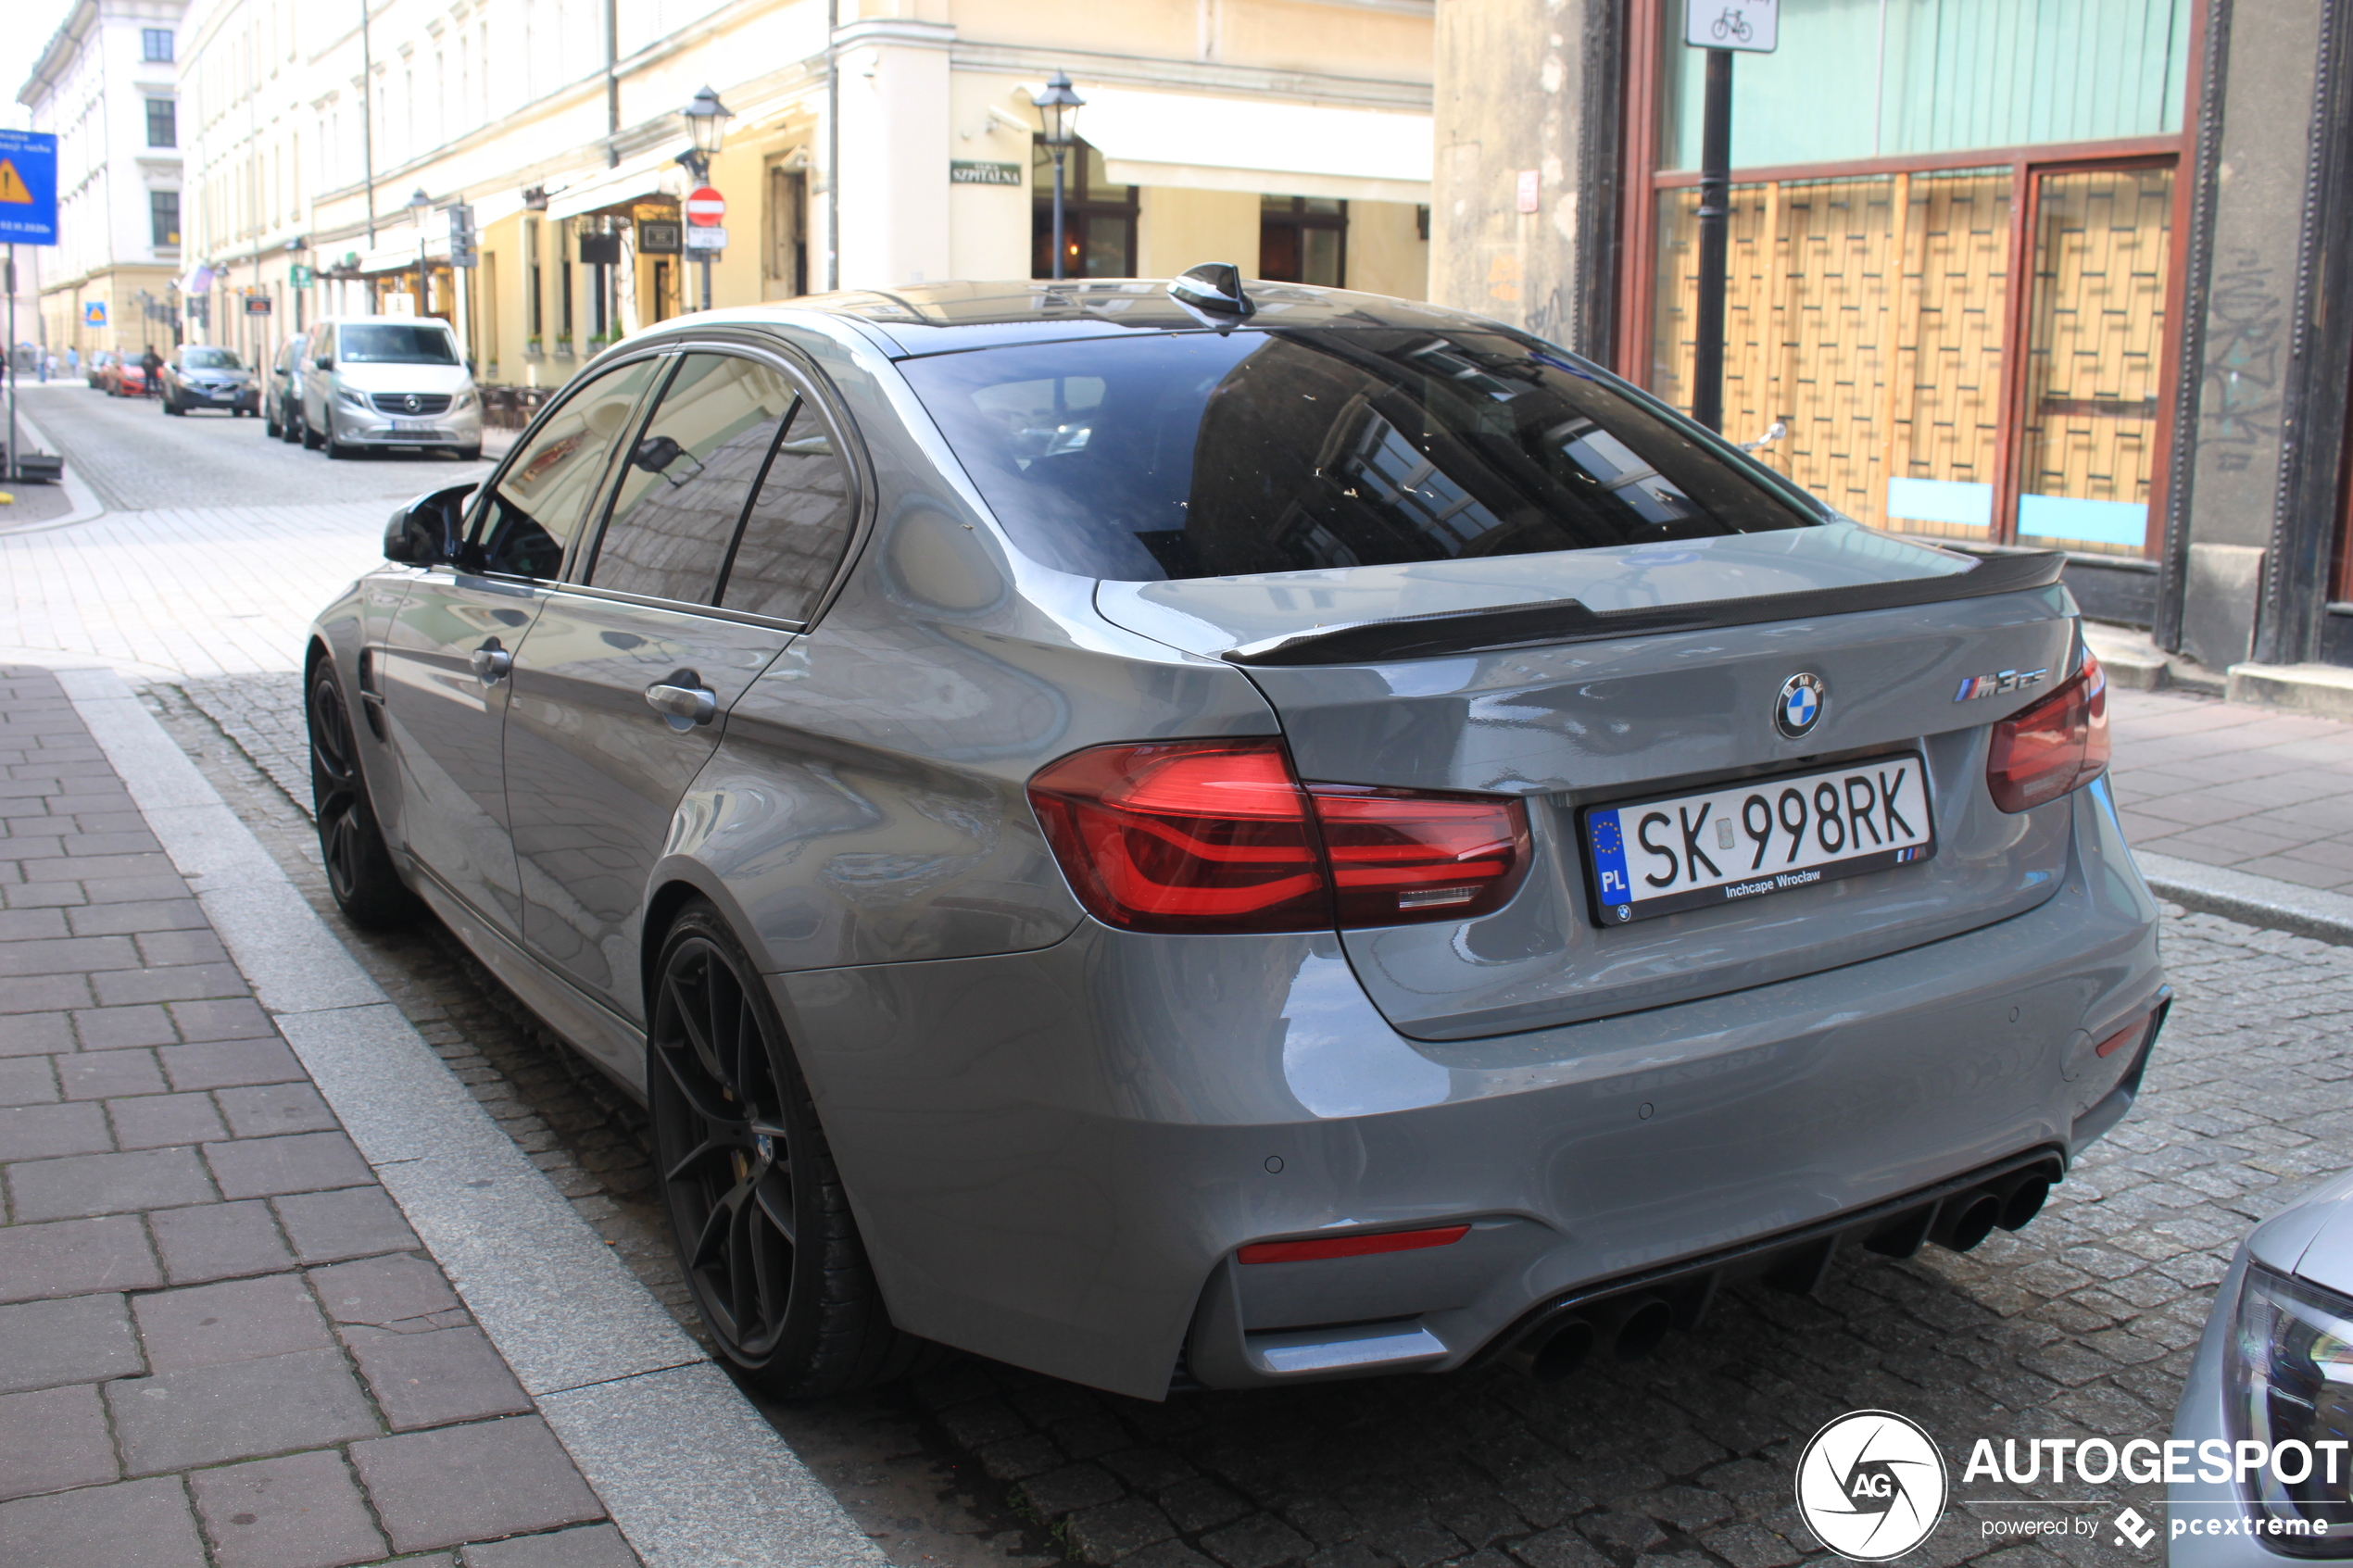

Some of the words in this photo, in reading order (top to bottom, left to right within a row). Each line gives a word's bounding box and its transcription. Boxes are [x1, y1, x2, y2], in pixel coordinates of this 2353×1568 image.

[952, 168, 1020, 183] SZPITALNA
[1637, 801, 1723, 888] SK
[1742, 768, 1916, 871] 998RK
[1601, 871, 1627, 894] PL
[1725, 879, 1775, 898] Inchcape
[1776, 870, 1821, 888] Wrocław
